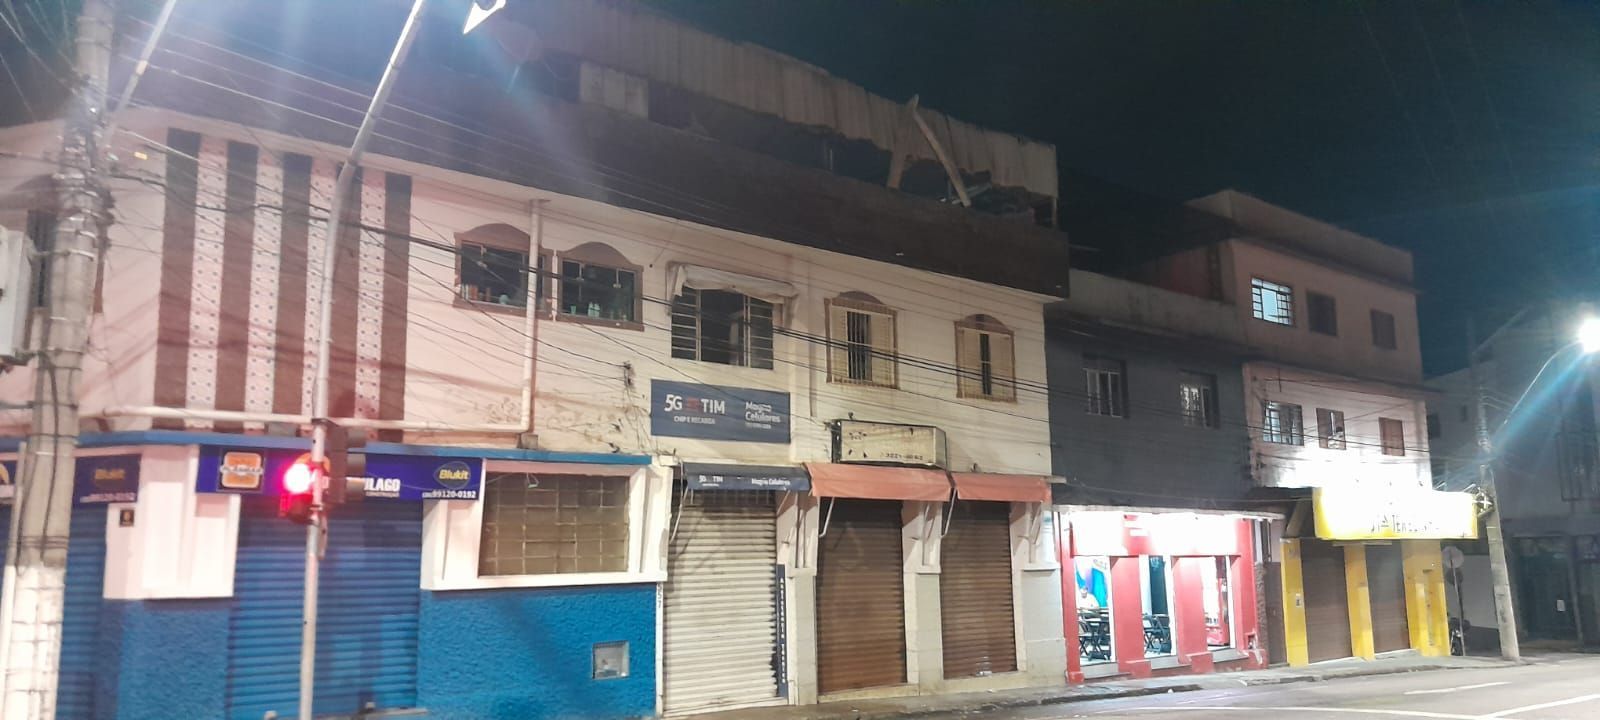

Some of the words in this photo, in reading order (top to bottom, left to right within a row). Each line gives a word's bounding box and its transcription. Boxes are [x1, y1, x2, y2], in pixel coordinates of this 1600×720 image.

[664, 394, 682, 411] 5G
[700, 398, 725, 414] TIM
[439, 469, 469, 480] Blukit
